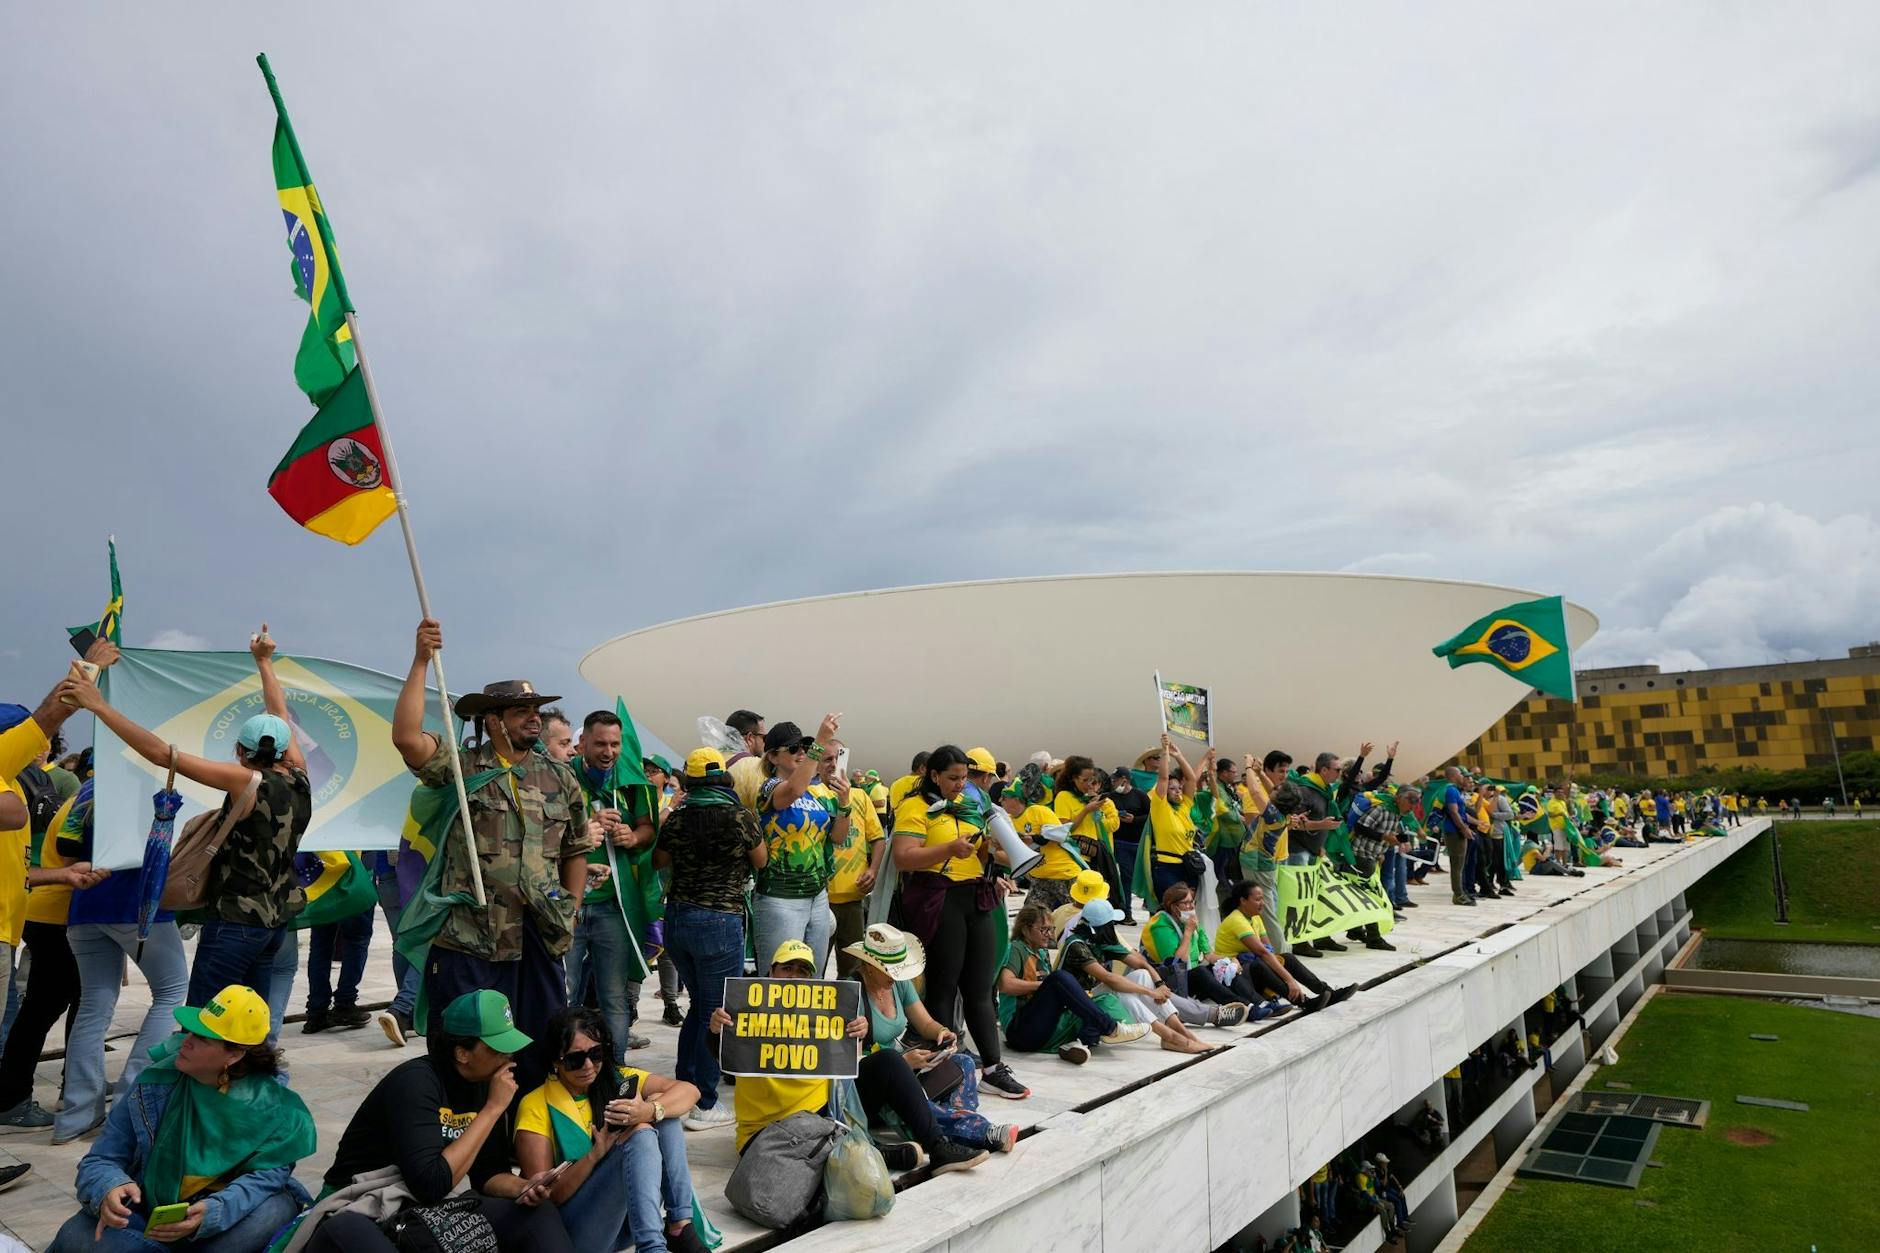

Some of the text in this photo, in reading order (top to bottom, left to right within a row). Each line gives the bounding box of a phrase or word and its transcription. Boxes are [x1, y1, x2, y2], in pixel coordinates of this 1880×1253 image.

[747, 982, 838, 1010] O PODER
[736, 1012, 845, 1041] EMANA DO
[759, 1043, 818, 1071] POVO
